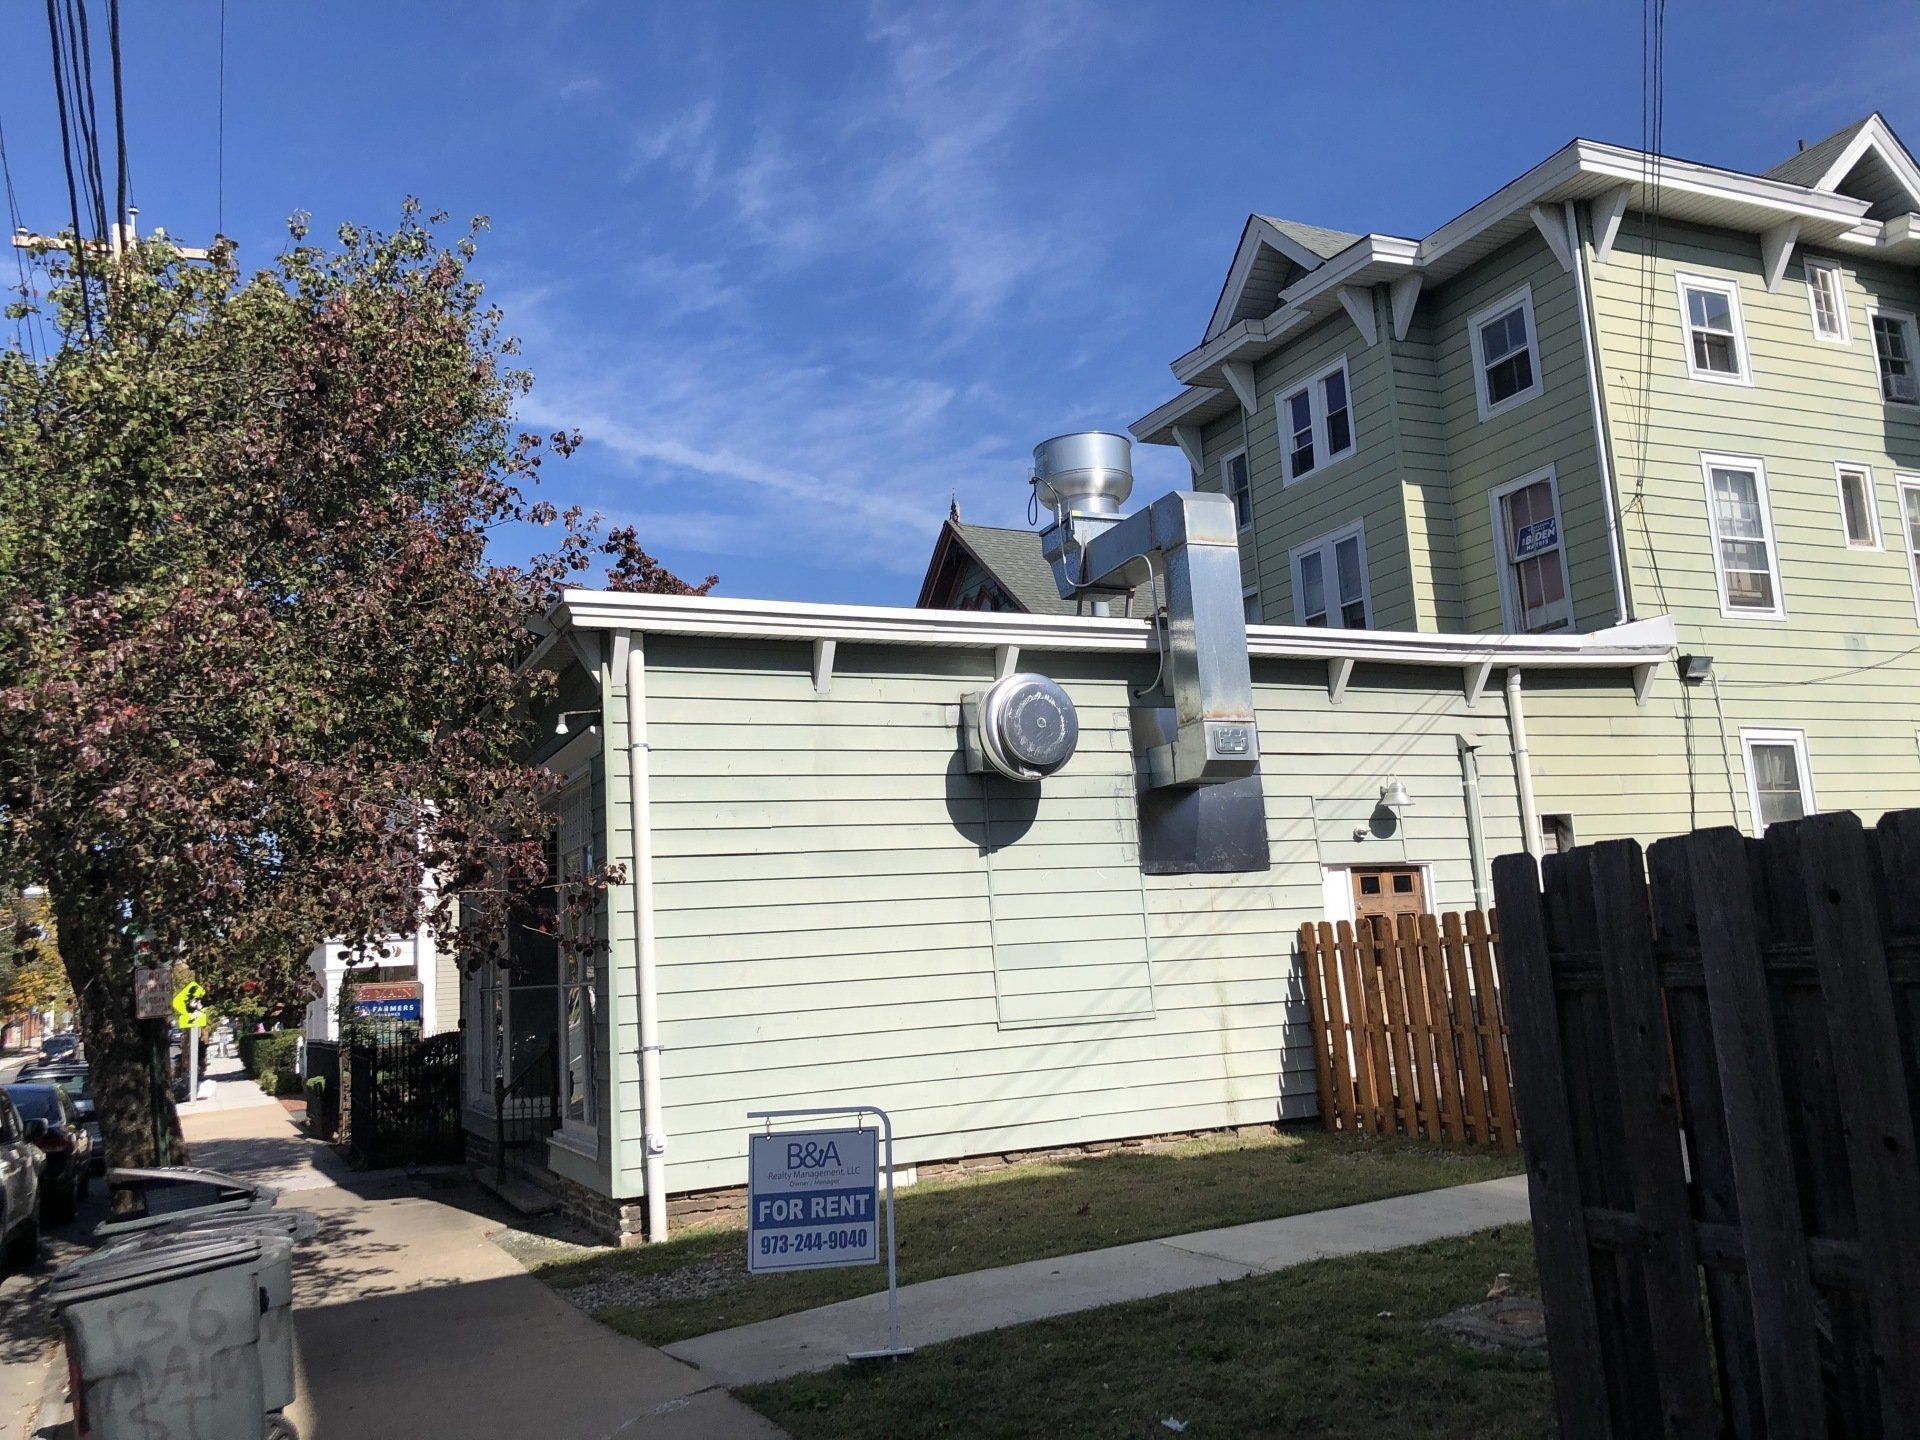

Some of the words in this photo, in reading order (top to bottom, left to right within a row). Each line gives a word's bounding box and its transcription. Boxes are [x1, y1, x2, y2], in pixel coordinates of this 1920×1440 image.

[372, 1004, 415, 1013] FARMERS
[787, 1141, 842, 1170] B&A
[768, 1170, 791, 1181] Realty
[793, 1169, 846, 1180] Management,
[846, 1166, 861, 1176] LLC
[759, 1198, 804, 1222] FOR
[811, 1193, 870, 1219] RENT
[760, 1228, 868, 1255] 973-244-9040
